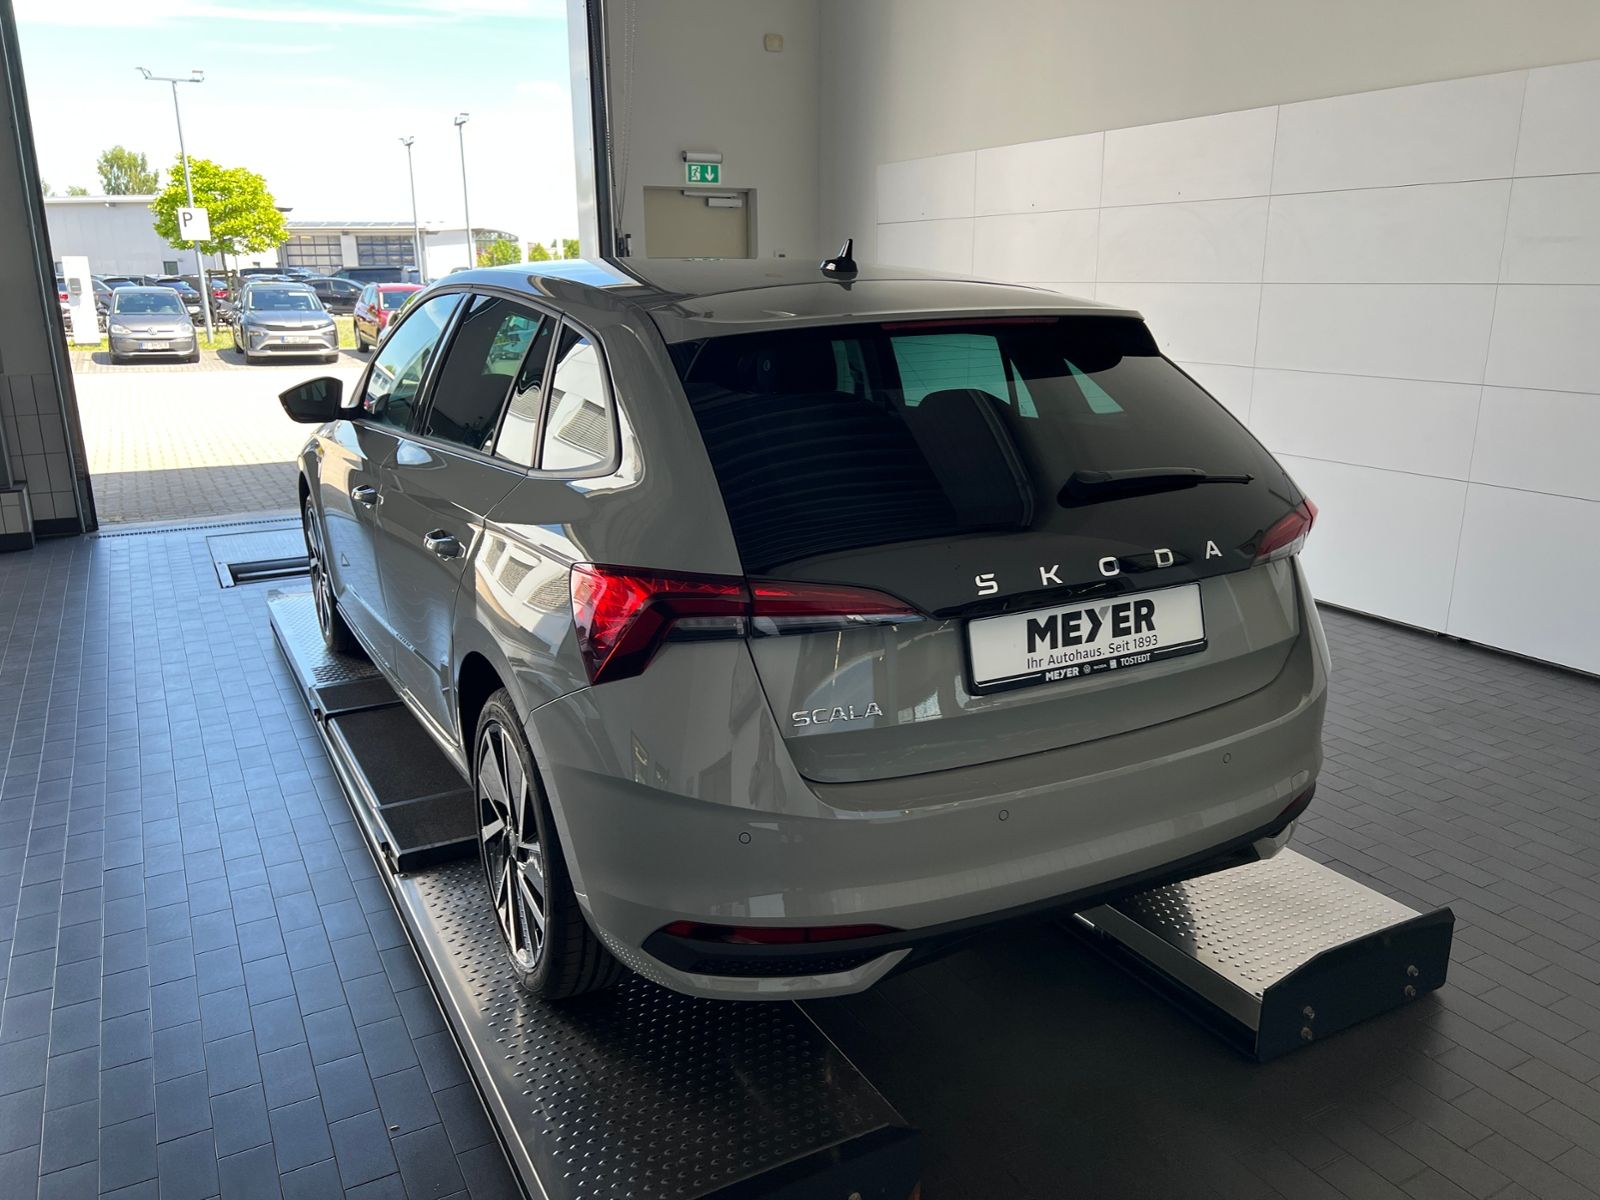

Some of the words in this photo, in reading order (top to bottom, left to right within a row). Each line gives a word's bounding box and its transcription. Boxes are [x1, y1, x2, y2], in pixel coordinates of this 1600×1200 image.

[182, 212, 193, 227] P
[1027, 599, 1156, 653] MEYER
[1027, 658, 1044, 669] Ihr
[1047, 648, 1105, 666] Autohaus.
[1108, 641, 1131, 654] Seit
[1133, 634, 1159, 649] 1893
[1046, 667, 1079, 681] MEYER
[1121, 653, 1151, 666] TOSTEDT
[792, 702, 883, 727] SCALA
